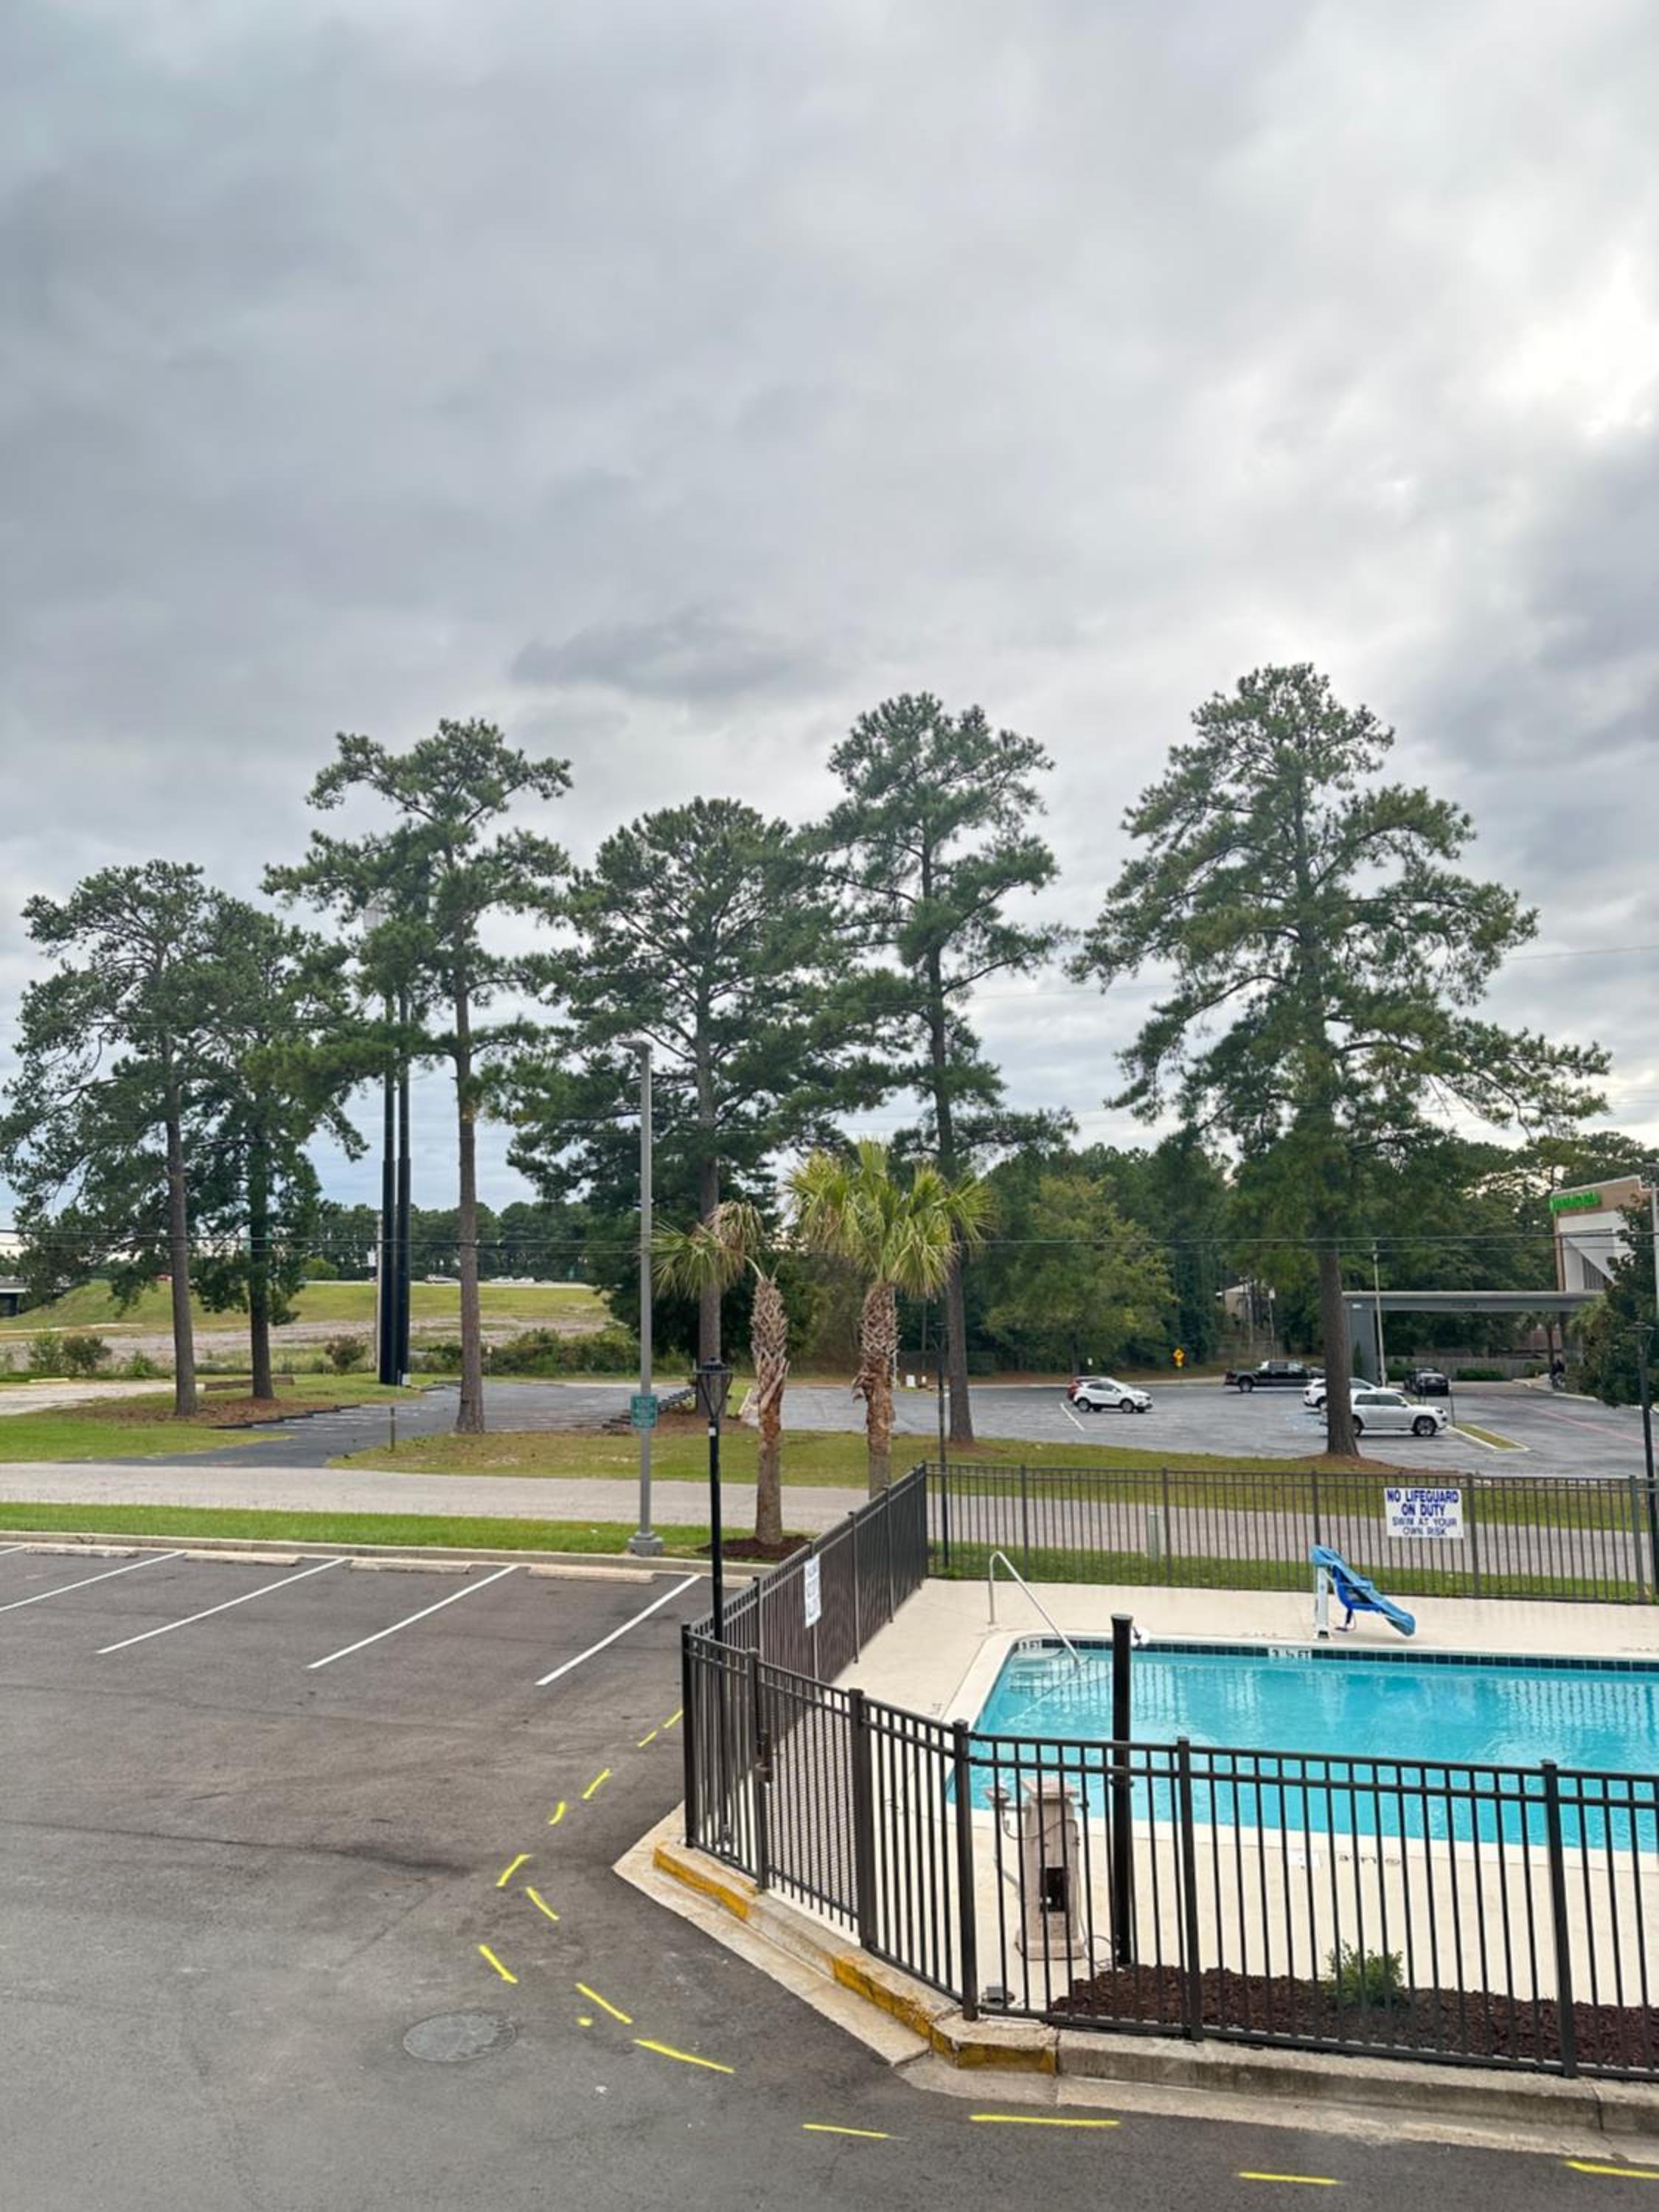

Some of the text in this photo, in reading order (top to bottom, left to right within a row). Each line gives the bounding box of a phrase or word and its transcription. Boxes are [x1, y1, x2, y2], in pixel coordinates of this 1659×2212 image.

[1387, 1489, 1458, 1503] NO LIFEGUARD
[1401, 1503, 1445, 1517] ON DUTY
[1392, 1517, 1457, 1526] SWIM AT YOUR
[1402, 1526, 1446, 1536] OWN RISK
